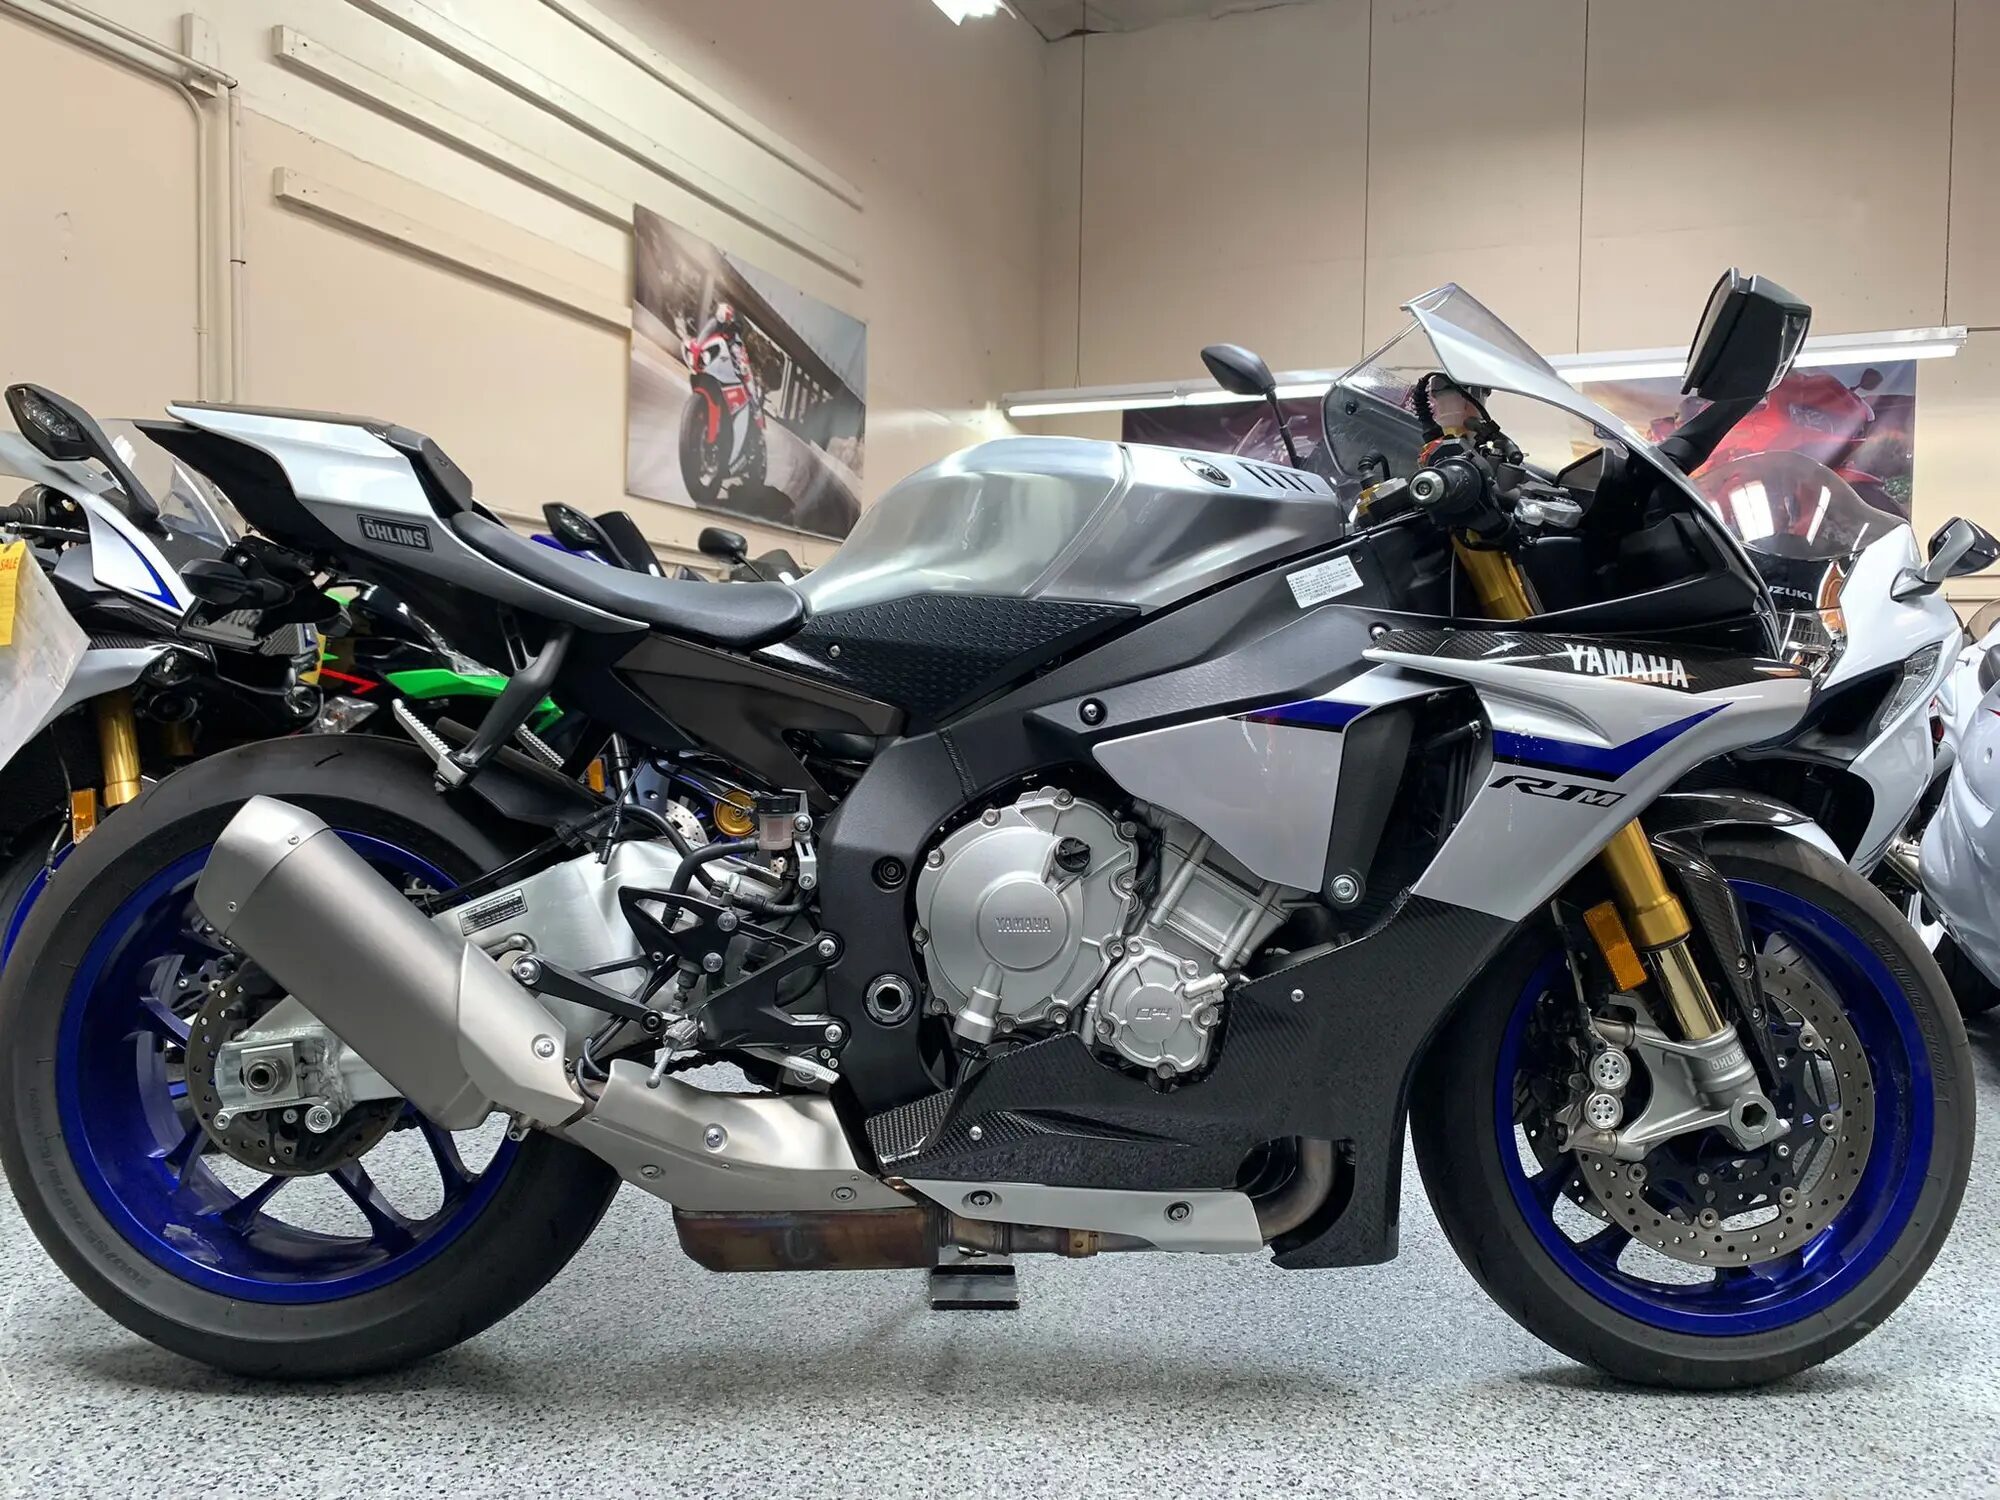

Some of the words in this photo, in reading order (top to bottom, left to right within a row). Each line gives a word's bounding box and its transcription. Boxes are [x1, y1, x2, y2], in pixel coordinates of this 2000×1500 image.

[363, 518, 427, 548] ÖHLINS
[1564, 643, 1689, 689] YAMAHA
[1488, 775, 1627, 808] R1M
[995, 917, 1052, 933] YAMAHA
